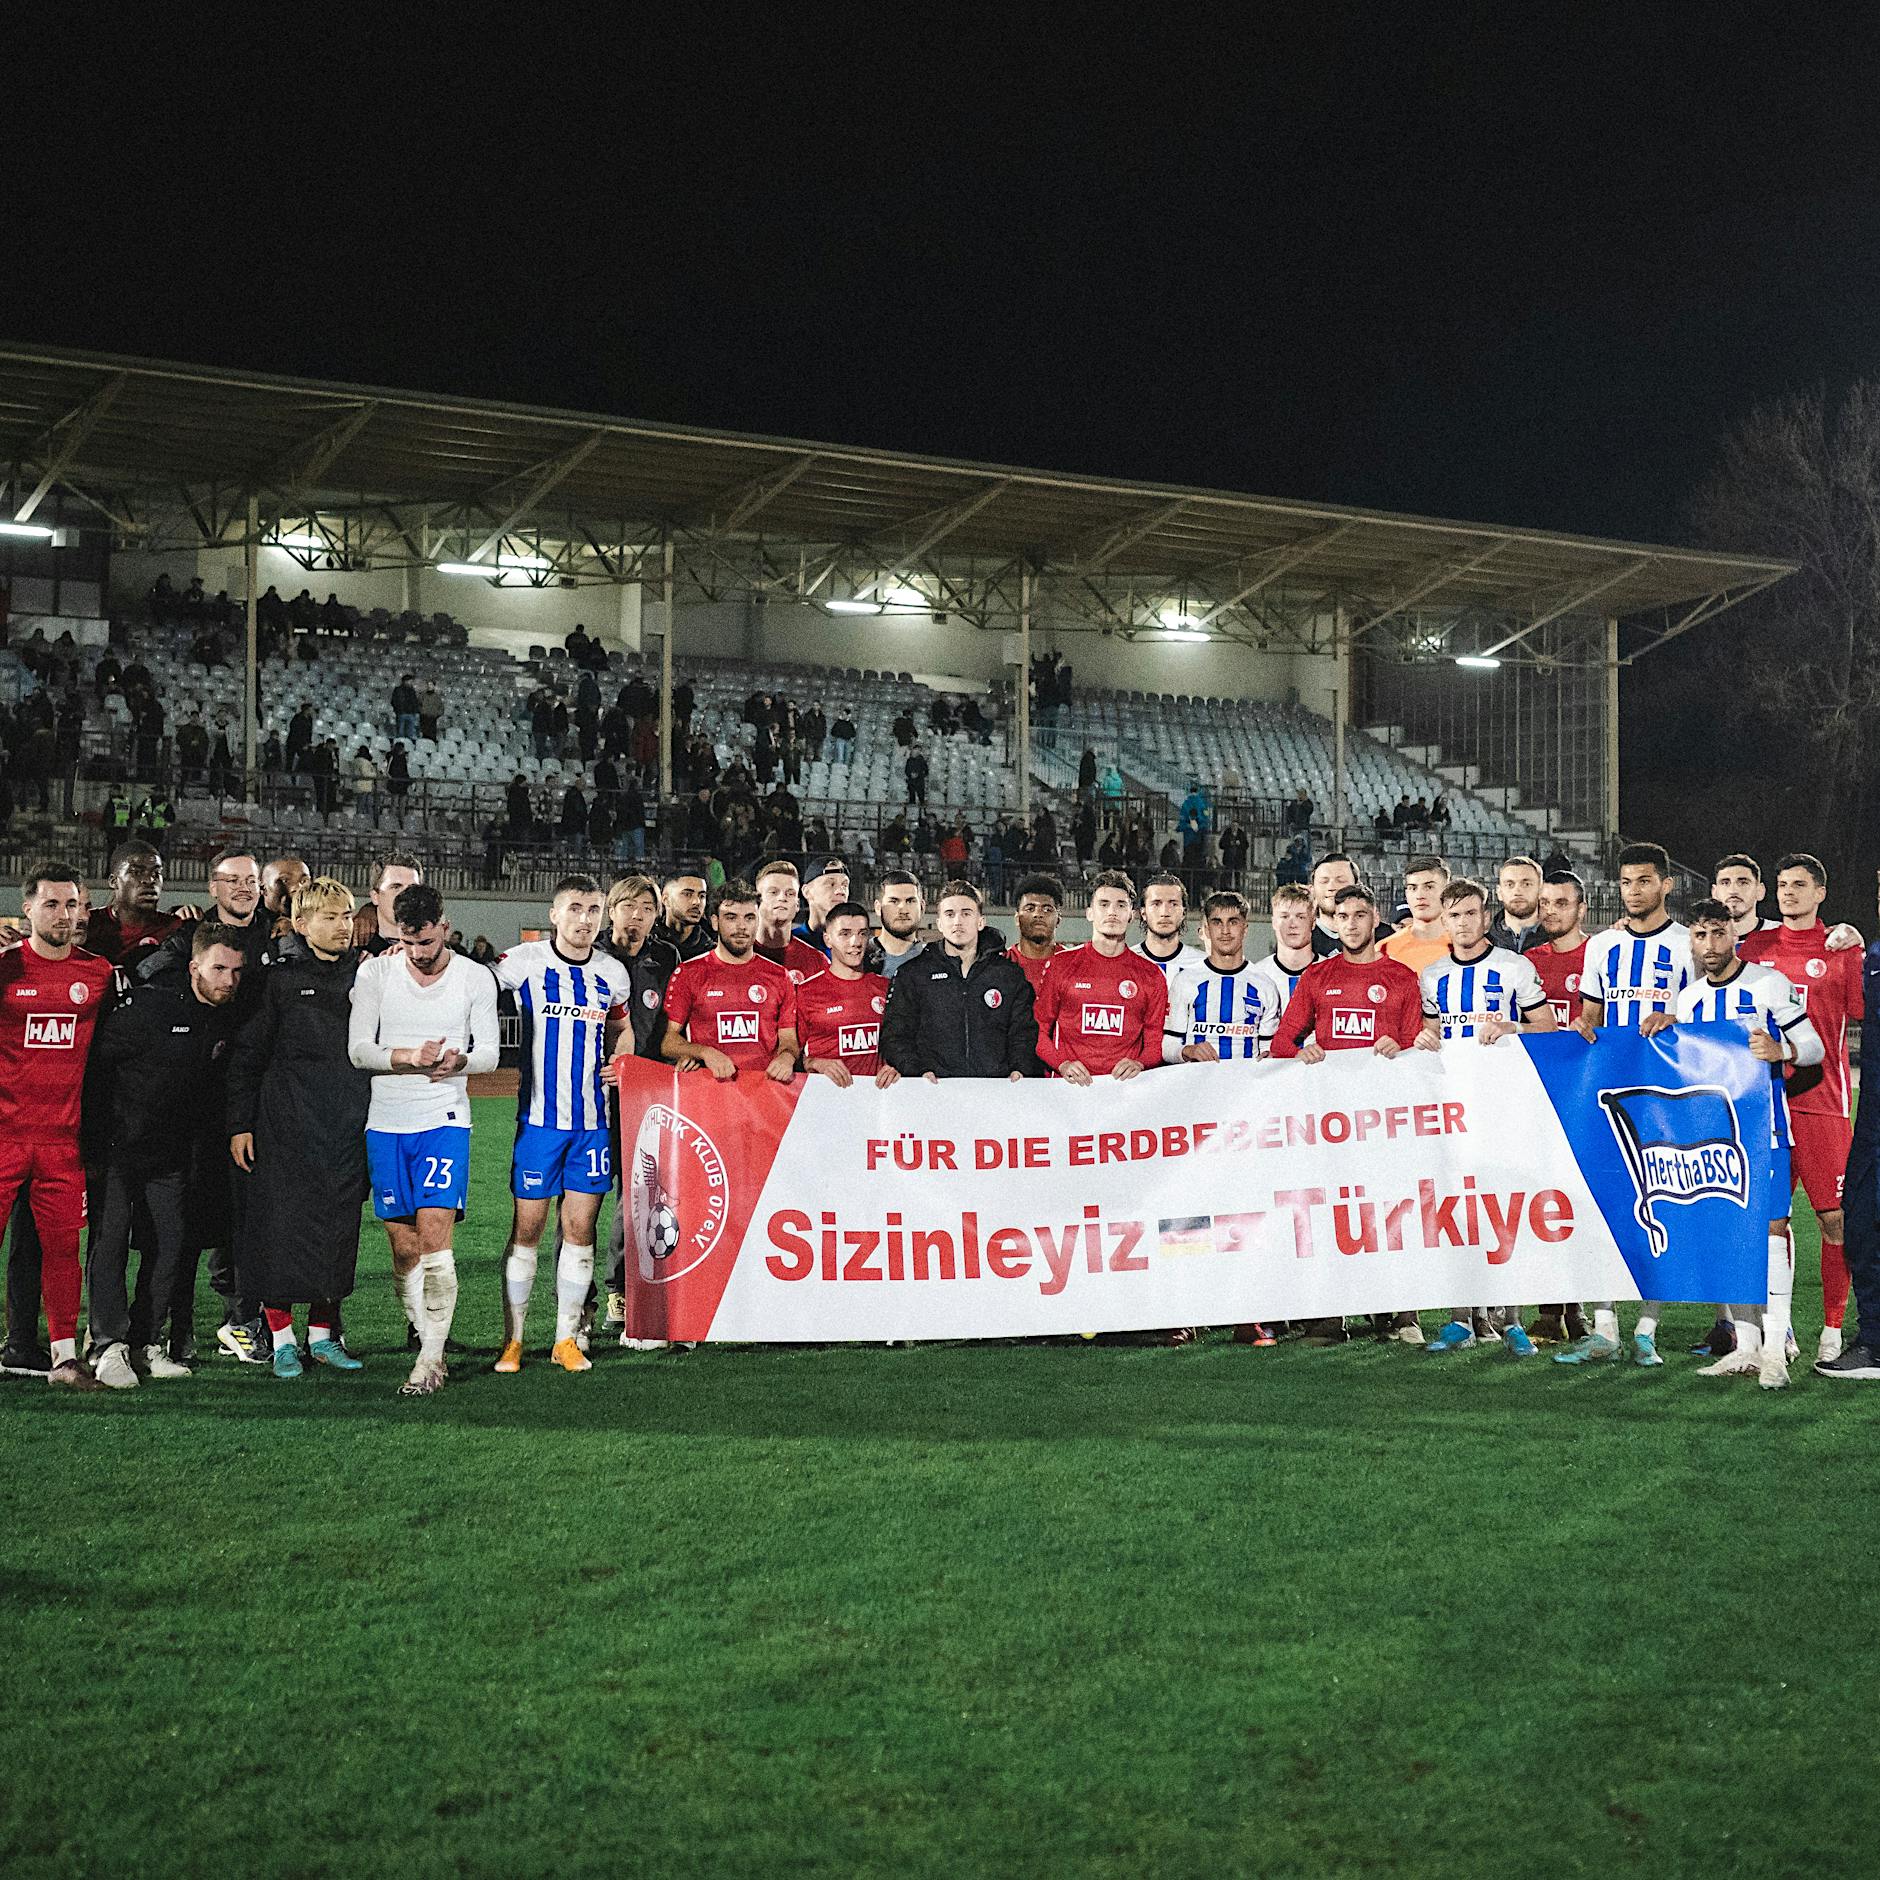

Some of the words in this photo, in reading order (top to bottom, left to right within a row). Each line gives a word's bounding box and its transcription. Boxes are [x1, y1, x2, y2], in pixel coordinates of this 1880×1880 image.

[16, 989, 37, 997] JAKO
[541, 1004, 606, 1020] AUTOHER
[826, 1005, 844, 1014] JAKO
[1085, 1009, 1121, 1031] HAN
[1441, 1012, 1504, 1025] AUTOHERO
[29, 1018, 73, 1043] HAN
[721, 1015, 756, 1038] HAN
[1192, 1023, 1255, 1036] AUTOHERO
[1335, 1012, 1373, 1035] HAN
[842, 1028, 878, 1050] HAN
[866, 1133, 959, 1171] FÜR
[974, 1136, 1051, 1170] DIE
[1068, 1101, 1468, 1167] ERDBEBENOPFER
[423, 1157, 453, 1189] 23
[586, 1147, 610, 1177] 16
[690, 1136, 724, 1188] KLUB
[765, 1205, 1149, 1295] Sizinleyiz
[1273, 1175, 1575, 1265] Türkiye
